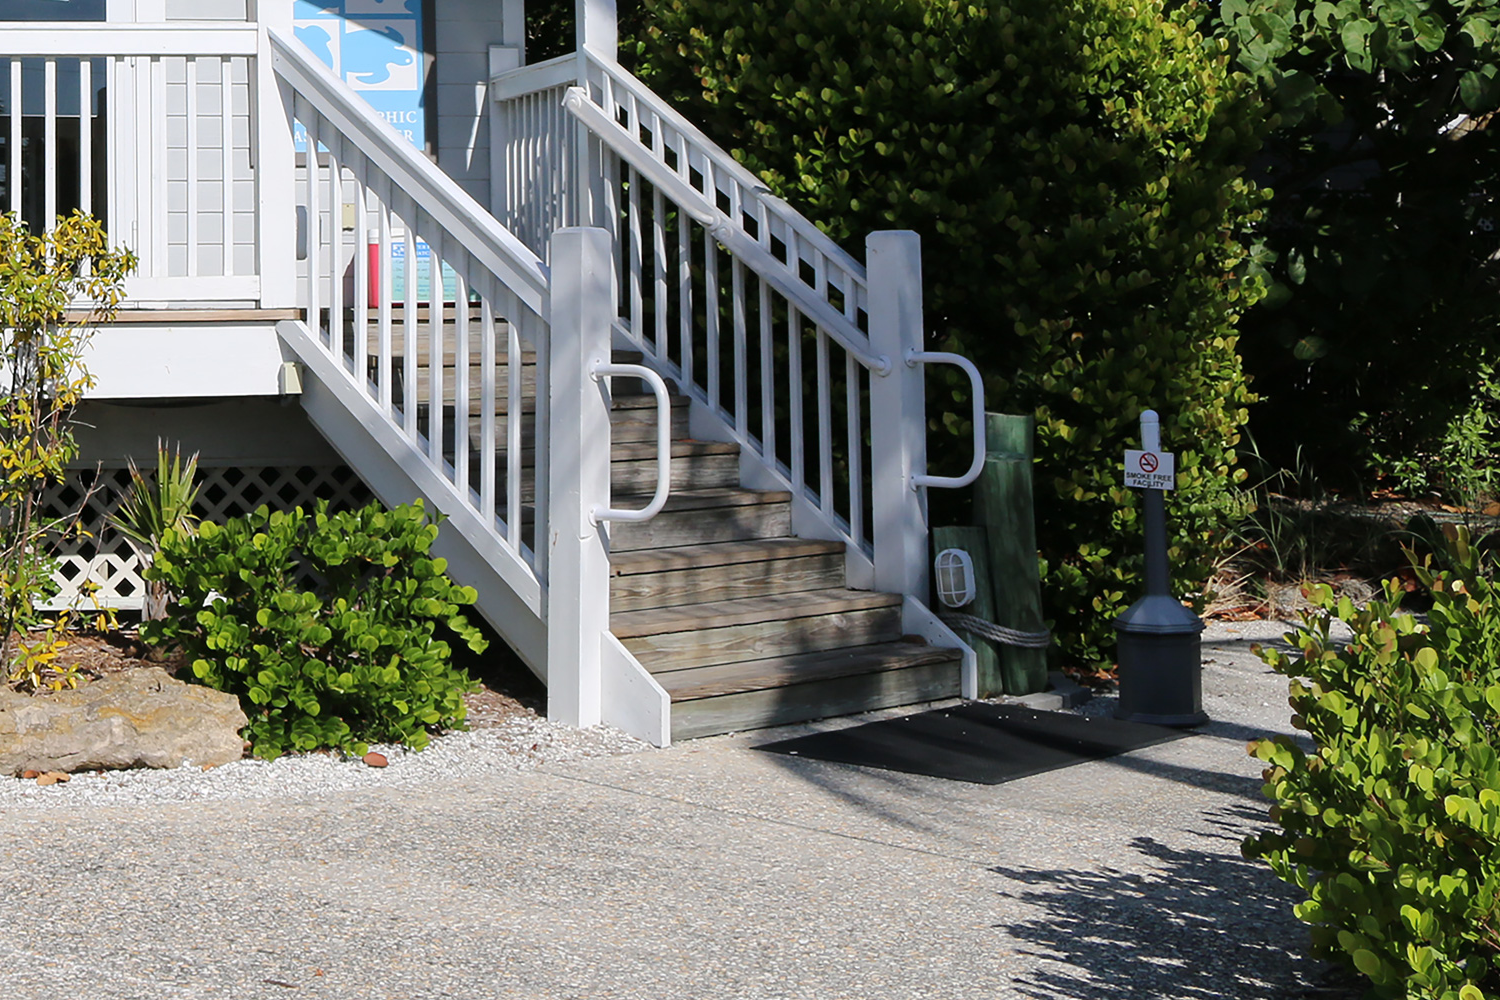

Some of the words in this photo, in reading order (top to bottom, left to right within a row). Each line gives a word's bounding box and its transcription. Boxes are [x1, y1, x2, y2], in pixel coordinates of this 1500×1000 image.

[1126, 472, 1150, 480] SMOKE
[1153, 474, 1172, 482] FREE
[1133, 479, 1164, 488] FACILITY
